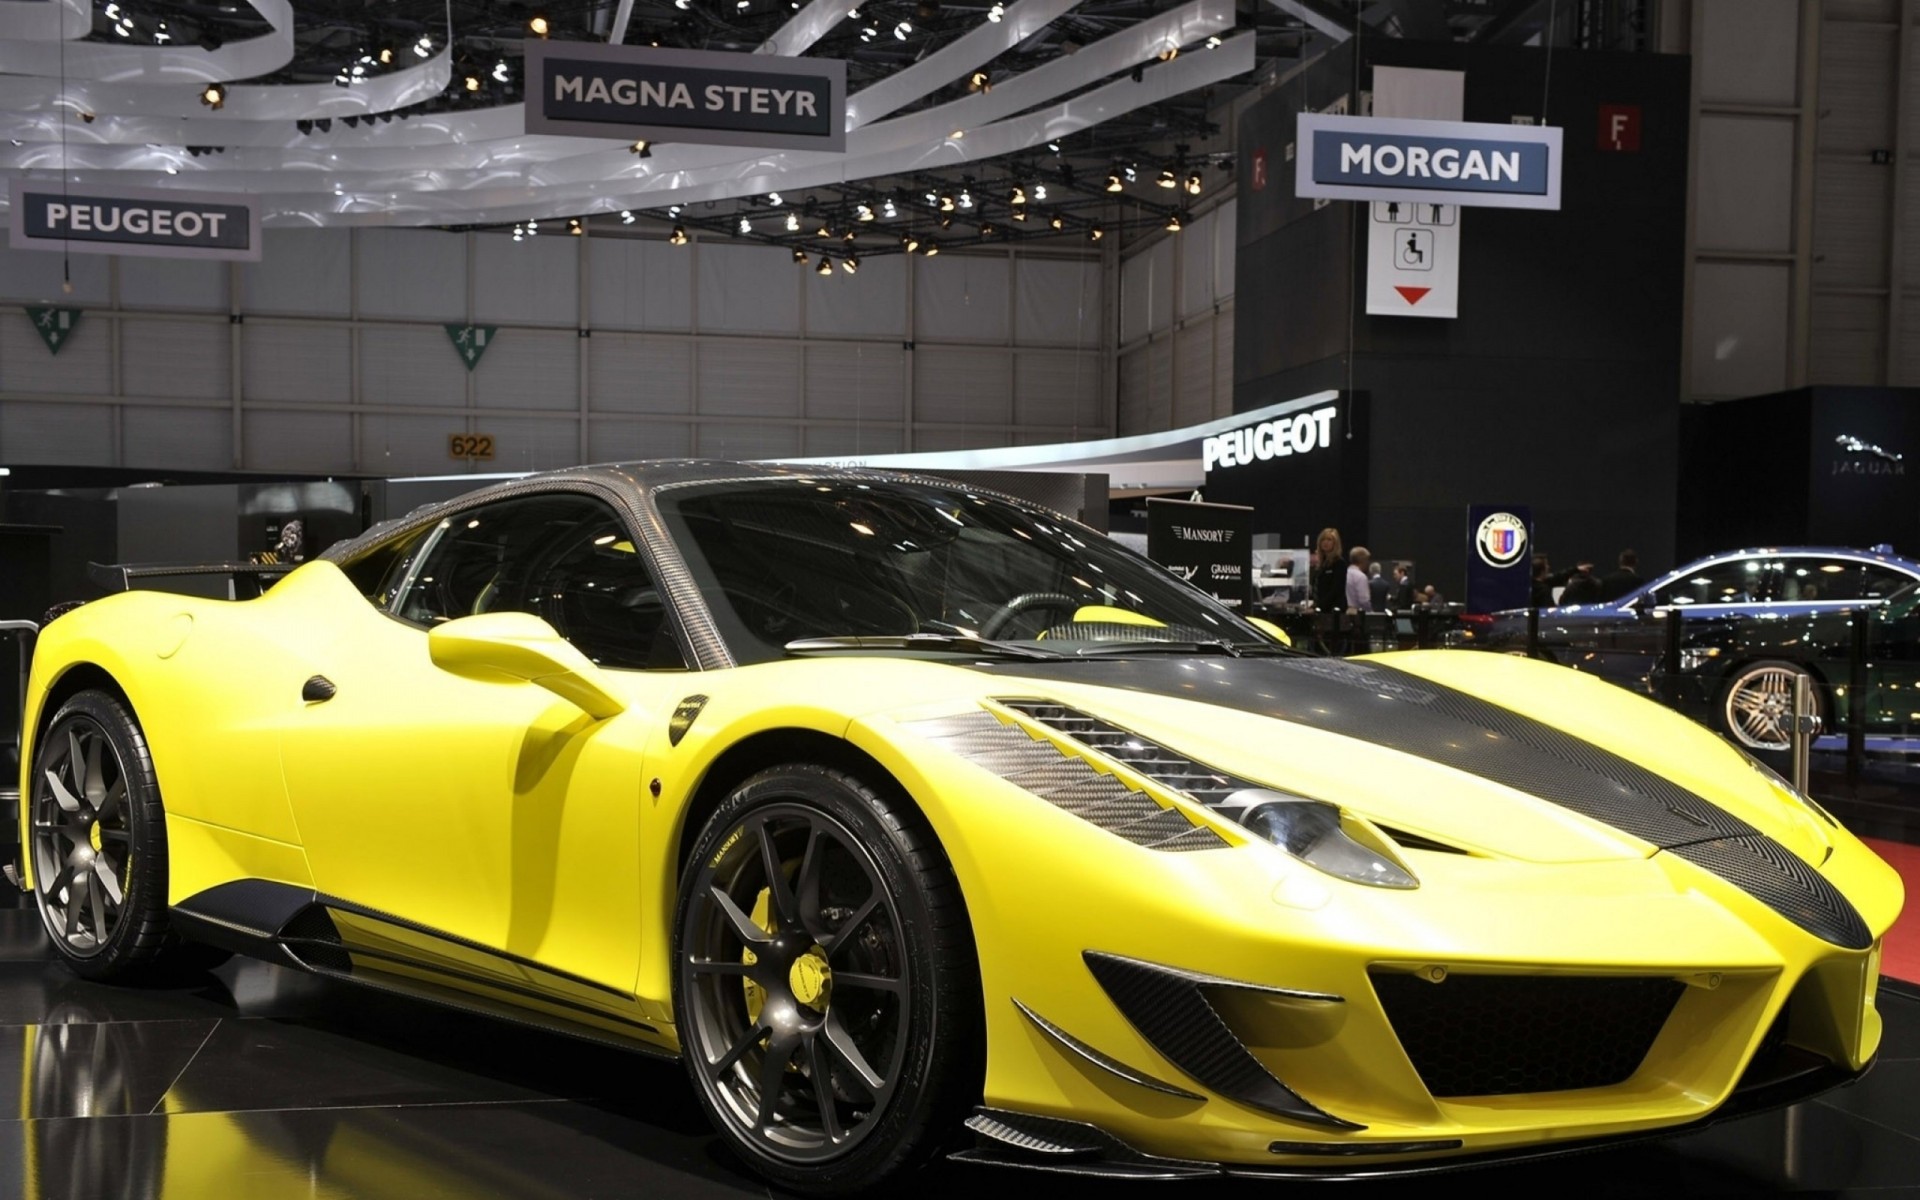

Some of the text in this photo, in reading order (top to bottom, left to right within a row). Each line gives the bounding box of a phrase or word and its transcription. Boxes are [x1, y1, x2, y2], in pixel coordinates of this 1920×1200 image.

[555, 75, 817, 117] MAGNA STEYR
[1341, 143, 1519, 182] MORGAN
[47, 203, 226, 238] PEUGEOT
[451, 436, 492, 456] 622
[1203, 406, 1336, 471] PEUGEOT
[1831, 461, 1905, 475] JAGUAR
